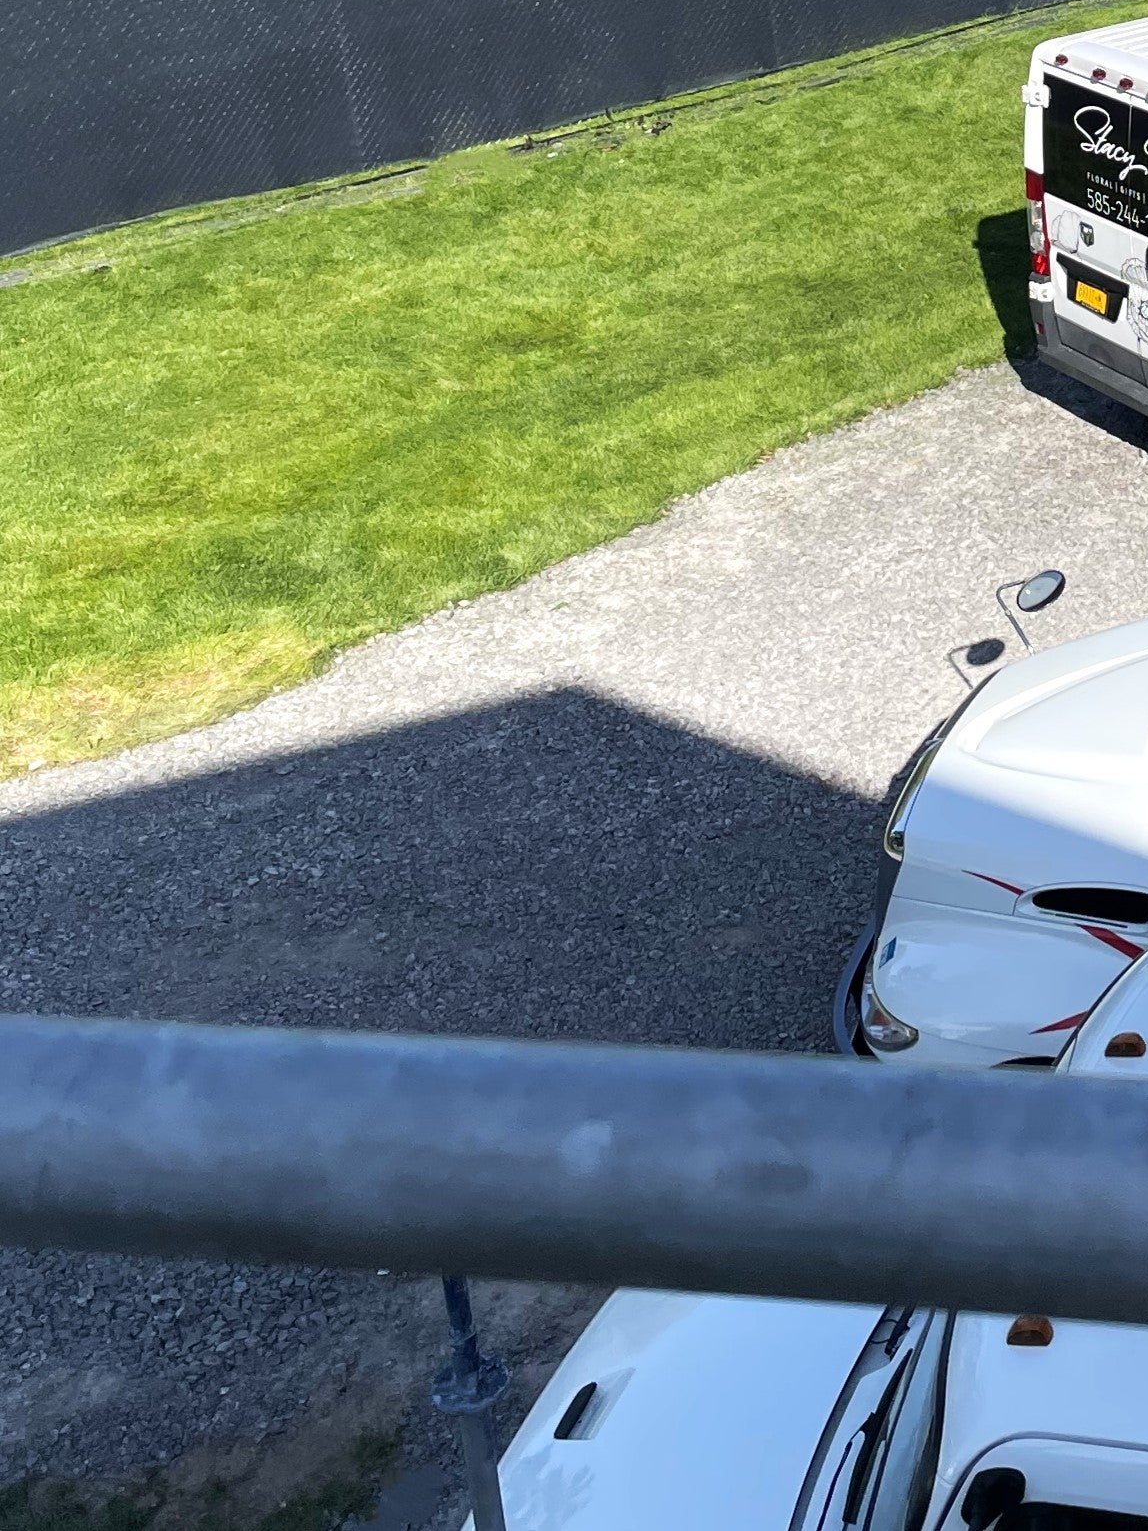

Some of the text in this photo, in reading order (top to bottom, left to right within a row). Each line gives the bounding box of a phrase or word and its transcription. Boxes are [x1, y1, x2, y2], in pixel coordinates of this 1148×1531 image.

[1073, 105, 1148, 180] Stacy
[1086, 171, 1113, 190] FLORAL
[1120, 185, 1141, 201] GIFTS
